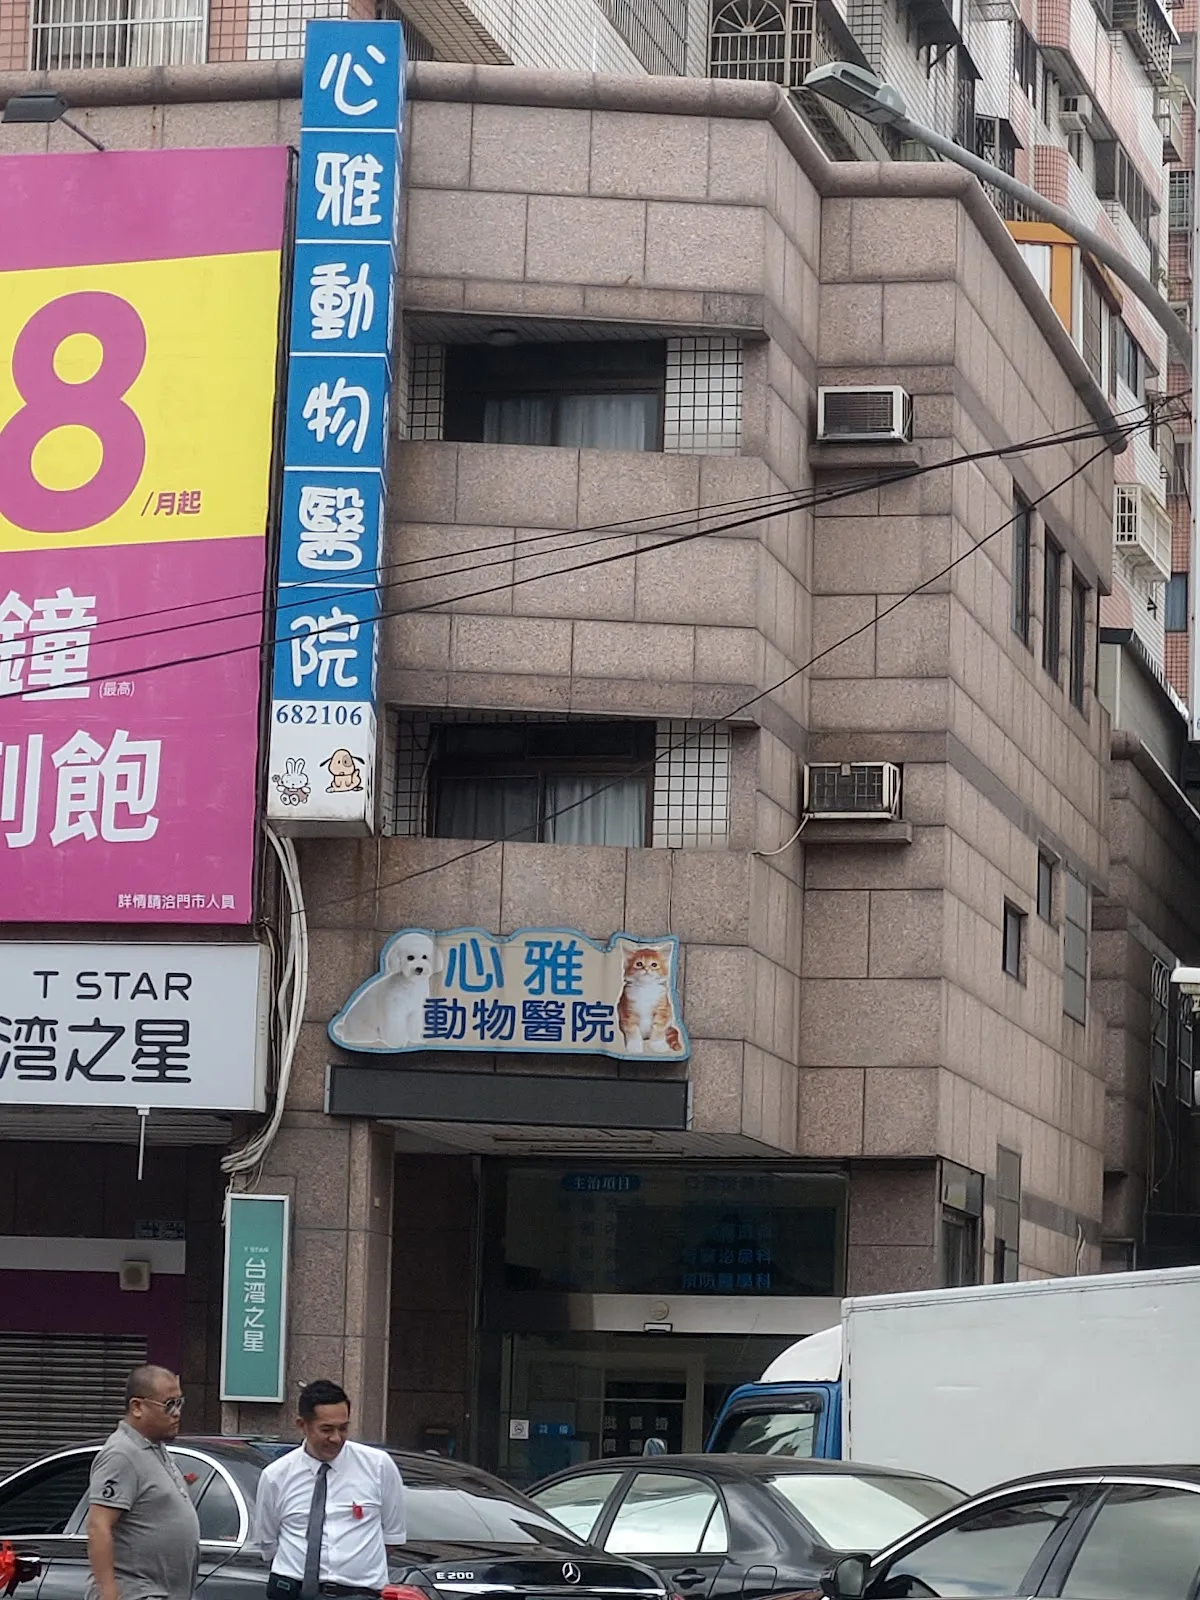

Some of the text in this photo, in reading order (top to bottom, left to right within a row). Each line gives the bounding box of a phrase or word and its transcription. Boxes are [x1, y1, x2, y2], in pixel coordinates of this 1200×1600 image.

[290, 44, 387, 688] 心雅動物醫院
[0, 290, 147, 533] 8
[276, 704, 362, 726] 682106
[118, 893, 236, 910] 詳情請洽門市人員
[33, 970, 192, 1001] T STAR
[444, 938, 584, 996] 心雅
[422, 997, 615, 1043] 動物醫院
[436, 1571, 474, 1580] E 200
